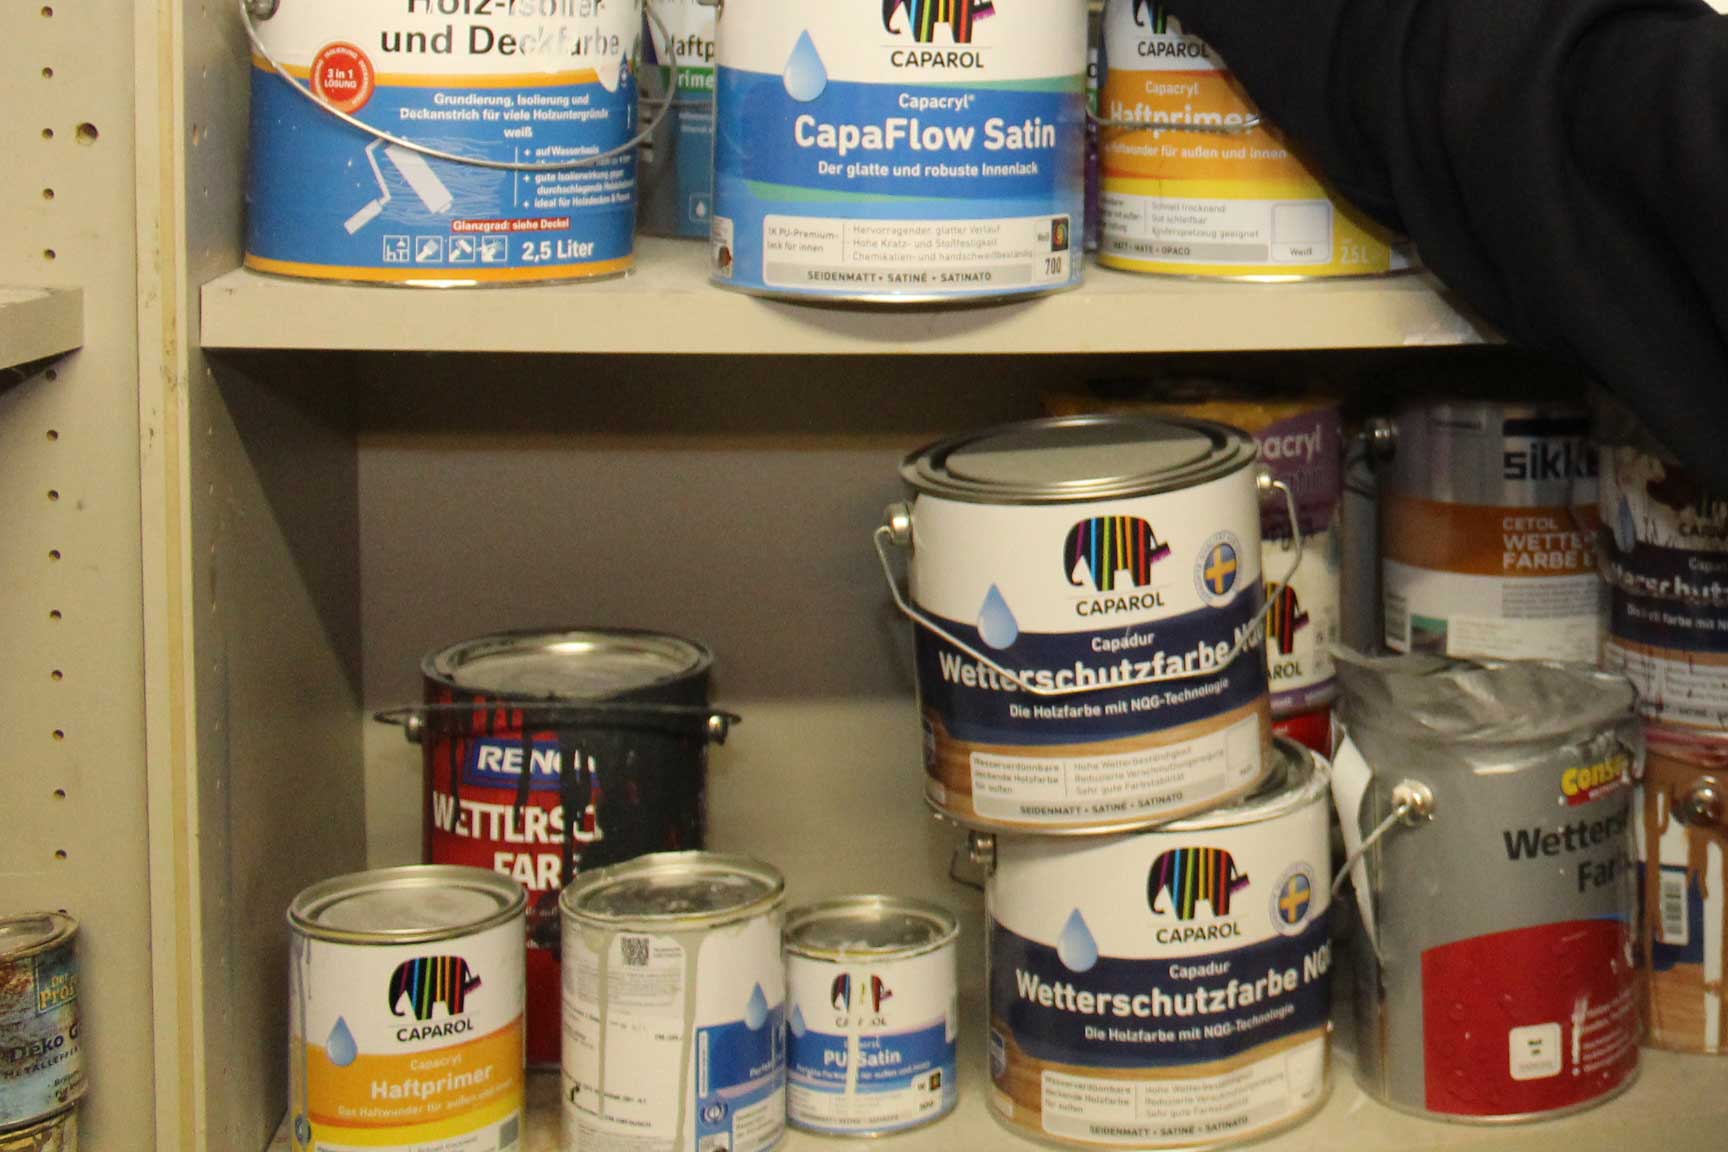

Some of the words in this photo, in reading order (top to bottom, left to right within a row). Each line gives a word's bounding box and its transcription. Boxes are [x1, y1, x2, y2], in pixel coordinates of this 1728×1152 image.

[381, 25, 453, 56] und
[1137, 40, 1210, 59] CAPAROL
[890, 50, 984, 70] CAPAROL
[327, 68, 334, 79] 3
[336, 68, 345, 79] in
[324, 78, 357, 89] LÖSUNG
[1145, 80, 1200, 97] Capacryl
[433, 93, 514, 108] Grundierung,
[517, 94, 570, 107] Isolierung
[571, 94, 590, 106] und
[399, 107, 480, 120] Deckanstrich
[483, 108, 500, 121] für
[503, 108, 530, 121] viele
[503, 126, 533, 139] weiß
[794, 114, 974, 156] CapaFlow
[983, 118, 1056, 151] Satin
[1161, 144, 1176, 158] für
[1181, 145, 1218, 159] außen
[1221, 146, 1246, 160] und
[534, 173, 556, 184] gute
[818, 160, 843, 176] Der
[847, 160, 889, 178] glatte
[893, 161, 920, 177] und
[924, 161, 979, 177] robuste
[981, 160, 1038, 176] Innenlack
[452, 219, 510, 232] Glanzgrad:
[512, 218, 539, 231] siehe
[540, 217, 570, 230] Deckel
[521, 241, 551, 262] 2,5
[556, 239, 595, 259] Liter
[914, 238, 933, 248] und
[919, 251, 937, 262] und
[807, 270, 876, 283] SEIDENMATT
[940, 271, 992, 283] SATINATO
[1503, 517, 1559, 530] CETOL
[1075, 591, 1165, 616] CAPAROL
[1091, 631, 1155, 653] Capadur
[938, 638, 1231, 694] Wetterschutzfarbe
[1009, 703, 1031, 720] Die
[1034, 703, 1101, 720] Holzfarbe
[1104, 699, 1129, 716] mit
[1130, 677, 1230, 711] NQG-Technologie
[1020, 805, 1081, 816] SEIDENMATT
[1138, 791, 1183, 809] SATINATO
[1156, 921, 1241, 945] CAPAROL
[1168, 960, 1232, 981] Capadur
[1015, 966, 1299, 1018] Wetterschutzfarbe
[396, 1017, 474, 1042] CAPAROL
[1084, 1025, 1105, 1041] Die
[1108, 1026, 1175, 1042] Holzfarbe
[1178, 1026, 1200, 1041] mit
[1204, 1002, 1295, 1039] NQG-Technologie
[410, 1054, 463, 1071] Capacryl
[823, 1048, 848, 1067] PU
[370, 1065, 493, 1100] Haftprimer
